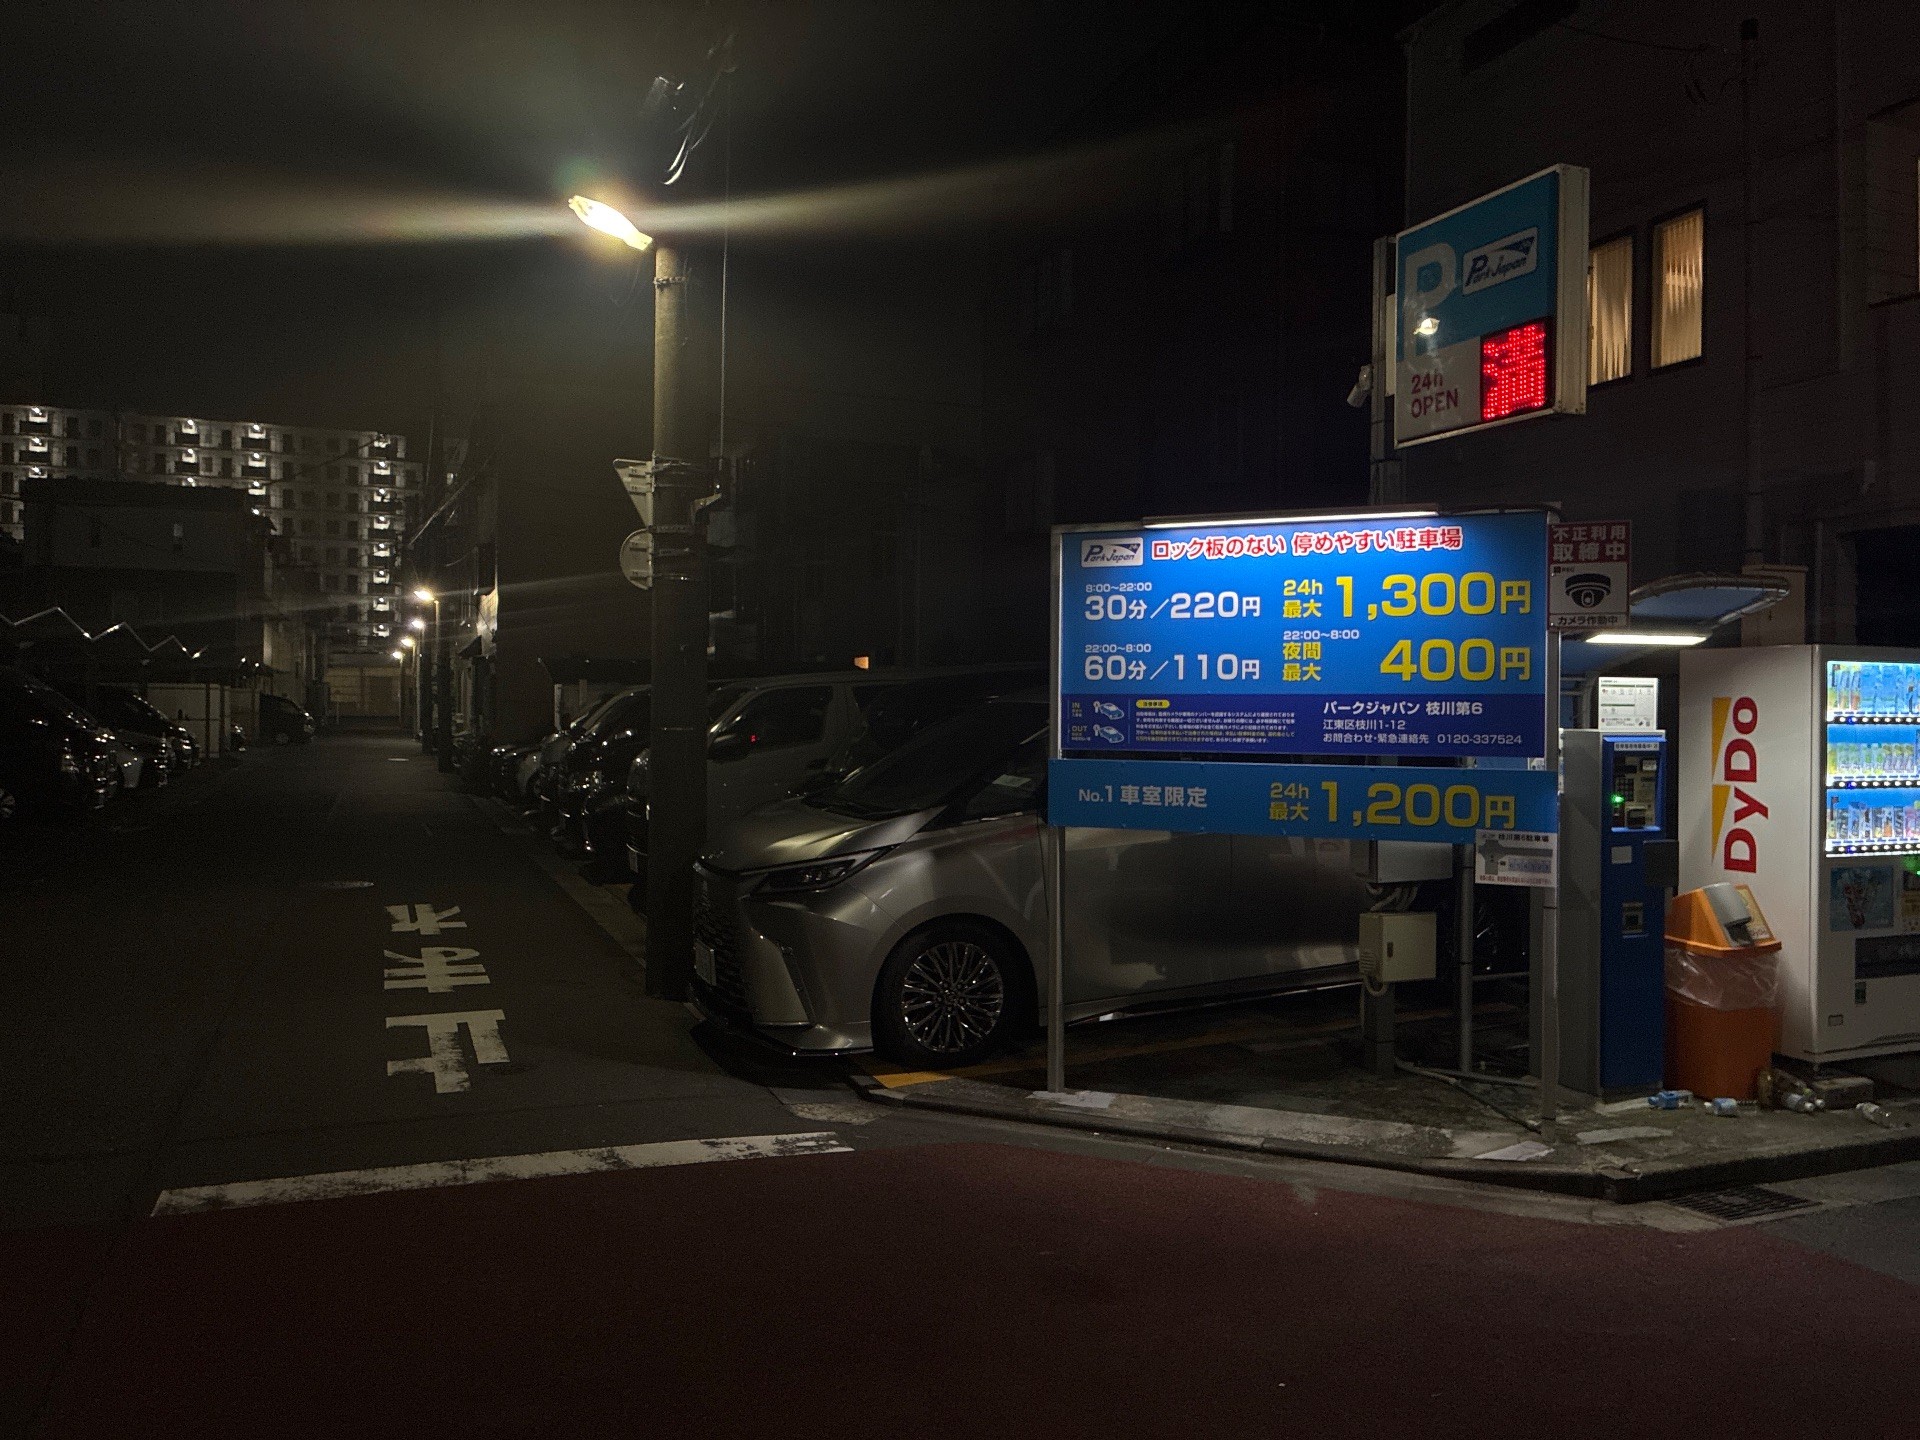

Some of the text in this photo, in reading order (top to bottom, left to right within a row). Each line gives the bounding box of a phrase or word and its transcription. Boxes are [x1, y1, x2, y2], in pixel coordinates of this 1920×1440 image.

[1411, 369, 1443, 394] 24h
[1411, 388, 1459, 418] OPEN
[1552, 525, 1626, 541] 不正利用
[1084, 544, 1106, 562] Park
[1152, 526, 1463, 561] ロック板のない 停めやすい駐車場
[1552, 541, 1626, 561] 取締中
[1283, 579, 1323, 596] 24h
[1336, 571, 1531, 621] 1,300円
[1283, 599, 1322, 618] 最大
[1283, 641, 1322, 661] 夜間
[1379, 638, 1531, 682] 400円
[1282, 663, 1322, 682] 最大
[1323, 701, 1483, 716] パークジャパン 枝川第6
[1323, 719, 1406, 731] 江東区枝川1-12
[1437, 733, 1522, 745] 0120-337524
[1270, 782, 1309, 799] 24h
[1723, 696, 1769, 874] DyDo
[1078, 785, 1208, 808] No.1 車室限定
[1321, 781, 1516, 829] 1,200円
[1269, 801, 1310, 821] 最大
[384, 903, 511, 1094] 止まれ
